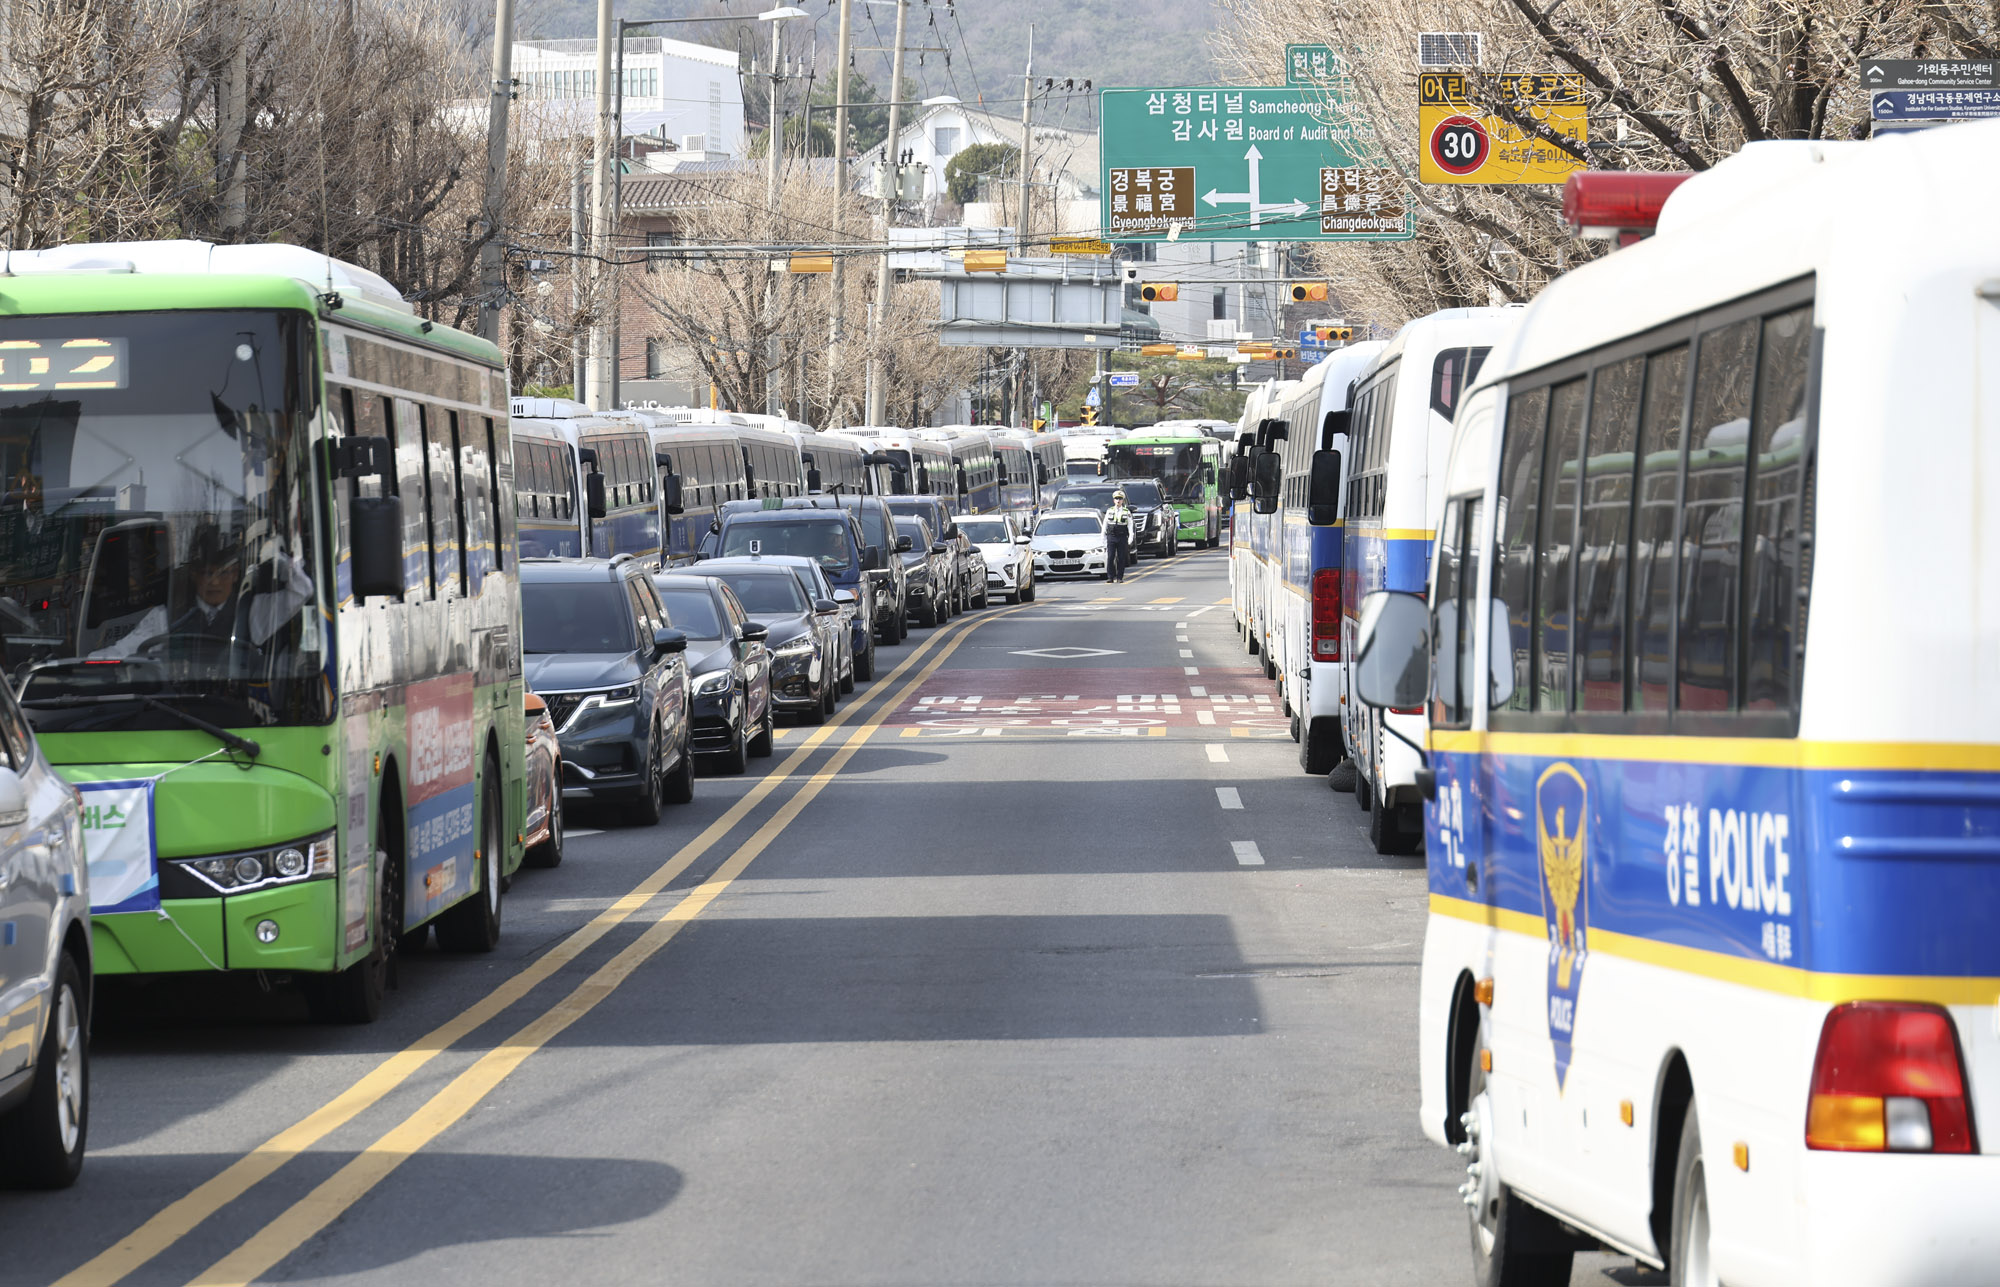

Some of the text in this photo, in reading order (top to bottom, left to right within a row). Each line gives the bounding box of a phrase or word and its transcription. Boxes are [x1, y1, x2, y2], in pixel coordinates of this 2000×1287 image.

[1917, 63, 1993, 76] 가회동주민센터
[1424, 77, 1582, 101] 어린보호구역
[1897, 78, 1928, 86] Gahoe-dong
[1928, 78, 1956, 86] Community
[1145, 92, 1244, 115] 삼청터널
[1249, 100, 1322, 117] Samcheong
[1907, 92, 2000, 105] 경남대극동문제연구소
[1171, 118, 1244, 142] 감사원
[1249, 126, 1280, 141] Board
[1284, 126, 1294, 141] of
[1301, 126, 1328, 141] Audit
[1331, 126, 1350, 141] and
[1444, 132, 1476, 159] 30
[1112, 169, 1176, 192] 경복궁
[1323, 169, 1381, 192] 창덕궁
[1112, 193, 1176, 213] 景福宮
[1323, 216, 1404, 232] Changdeokgung
[1664, 802, 1792, 916] 경찰 POLICE
